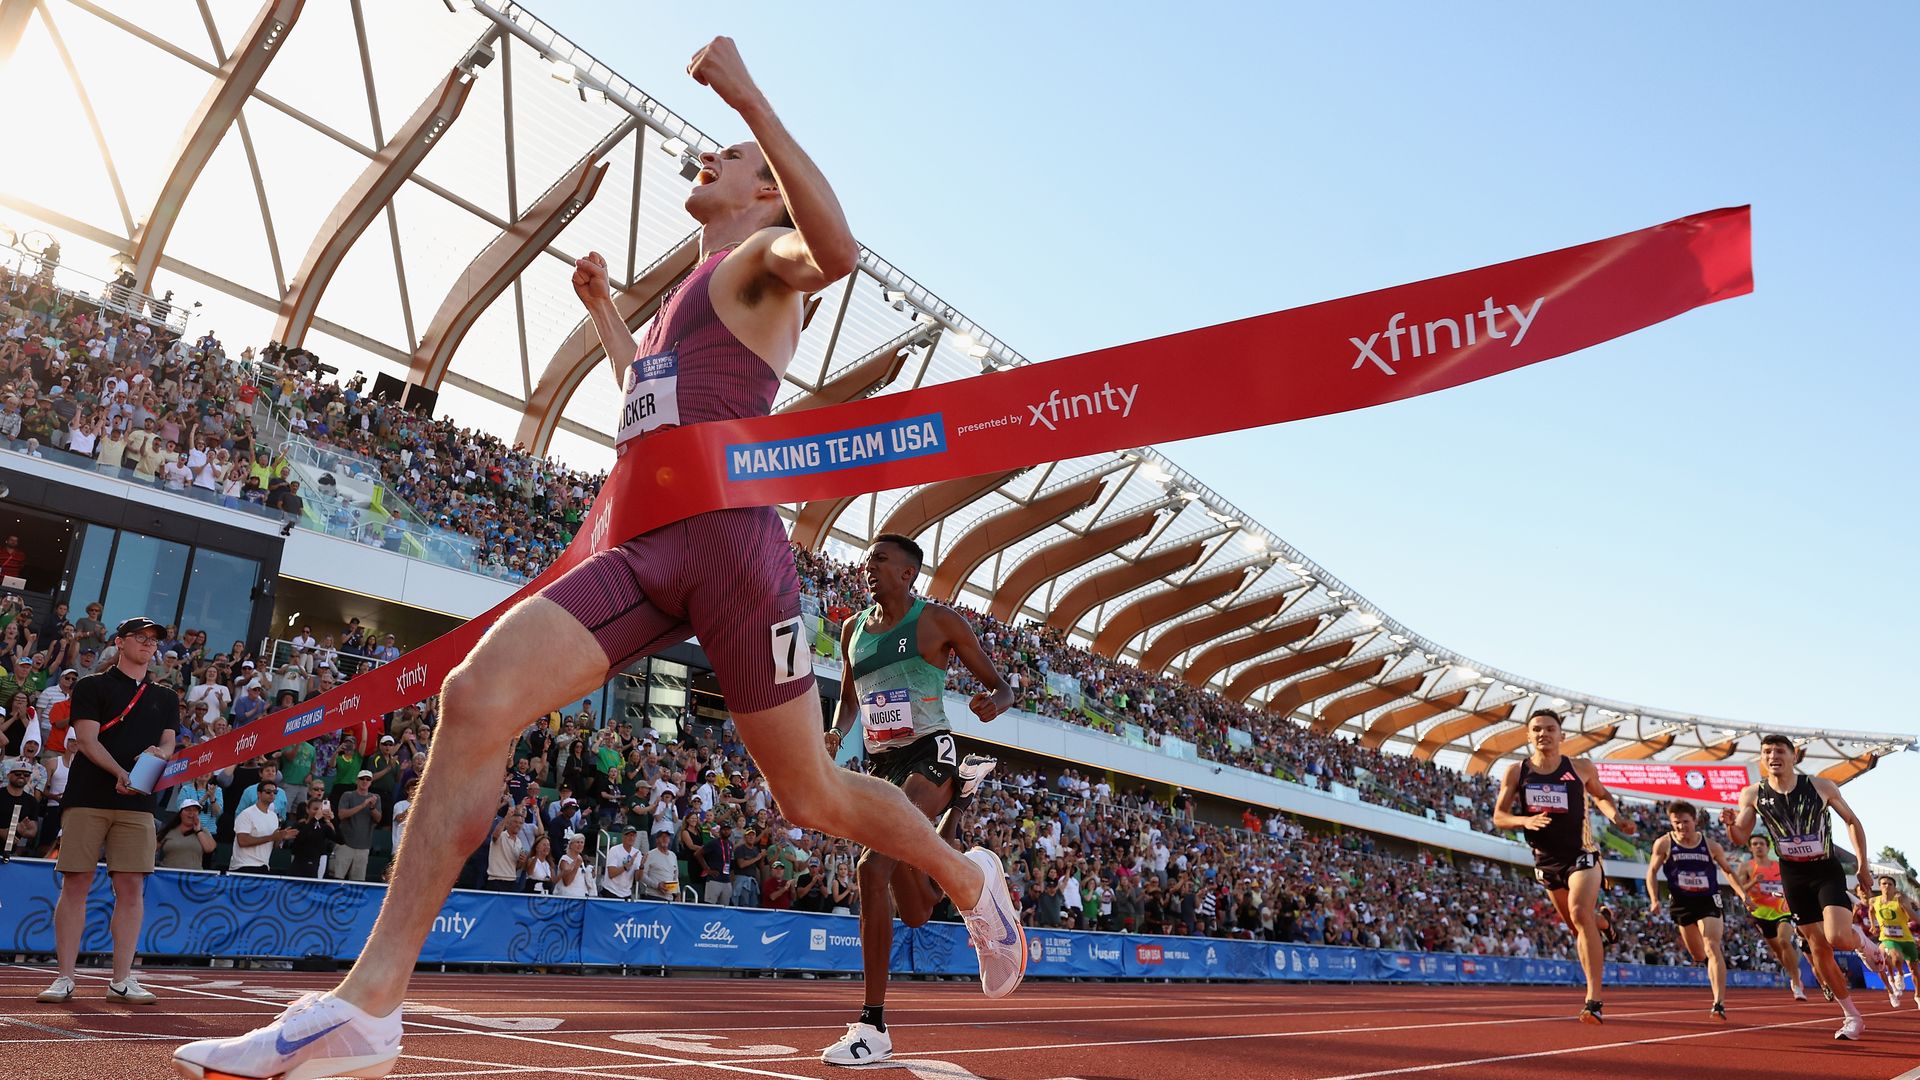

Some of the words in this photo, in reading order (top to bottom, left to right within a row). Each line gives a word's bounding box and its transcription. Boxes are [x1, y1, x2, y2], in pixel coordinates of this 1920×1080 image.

[1349, 296, 1545, 376] xfinity
[643, 365, 656, 374] TEAM
[656, 361, 673, 370] TRIALS
[618, 392, 656, 432] OCKER
[733, 441, 820, 474] MAKING
[824, 431, 885, 464] TEAM
[890, 421, 939, 454] USA
[957, 416, 1009, 437] presented
[1010, 413, 1023, 426] by
[1027, 381, 1139, 432] xfinity
[776, 621, 799, 677] 7
[396, 662, 428, 695] xfinity
[339, 693, 361, 716] xfinity
[870, 709, 902, 726] NUGUSE
[234, 731, 259, 756] xfinity
[940, 736, 954, 762] 2
[928, 765, 942, 778] OAC
[1533, 794, 1562, 804] KESSLER
[1788, 846, 1813, 855] CIATTEI
[431, 911, 476, 940] nity
[613, 917, 672, 944] xfinity
[700, 921, 735, 944] Lilly
[829, 934, 862, 947] TOYOTA
[1099, 950, 1120, 960] USATF
